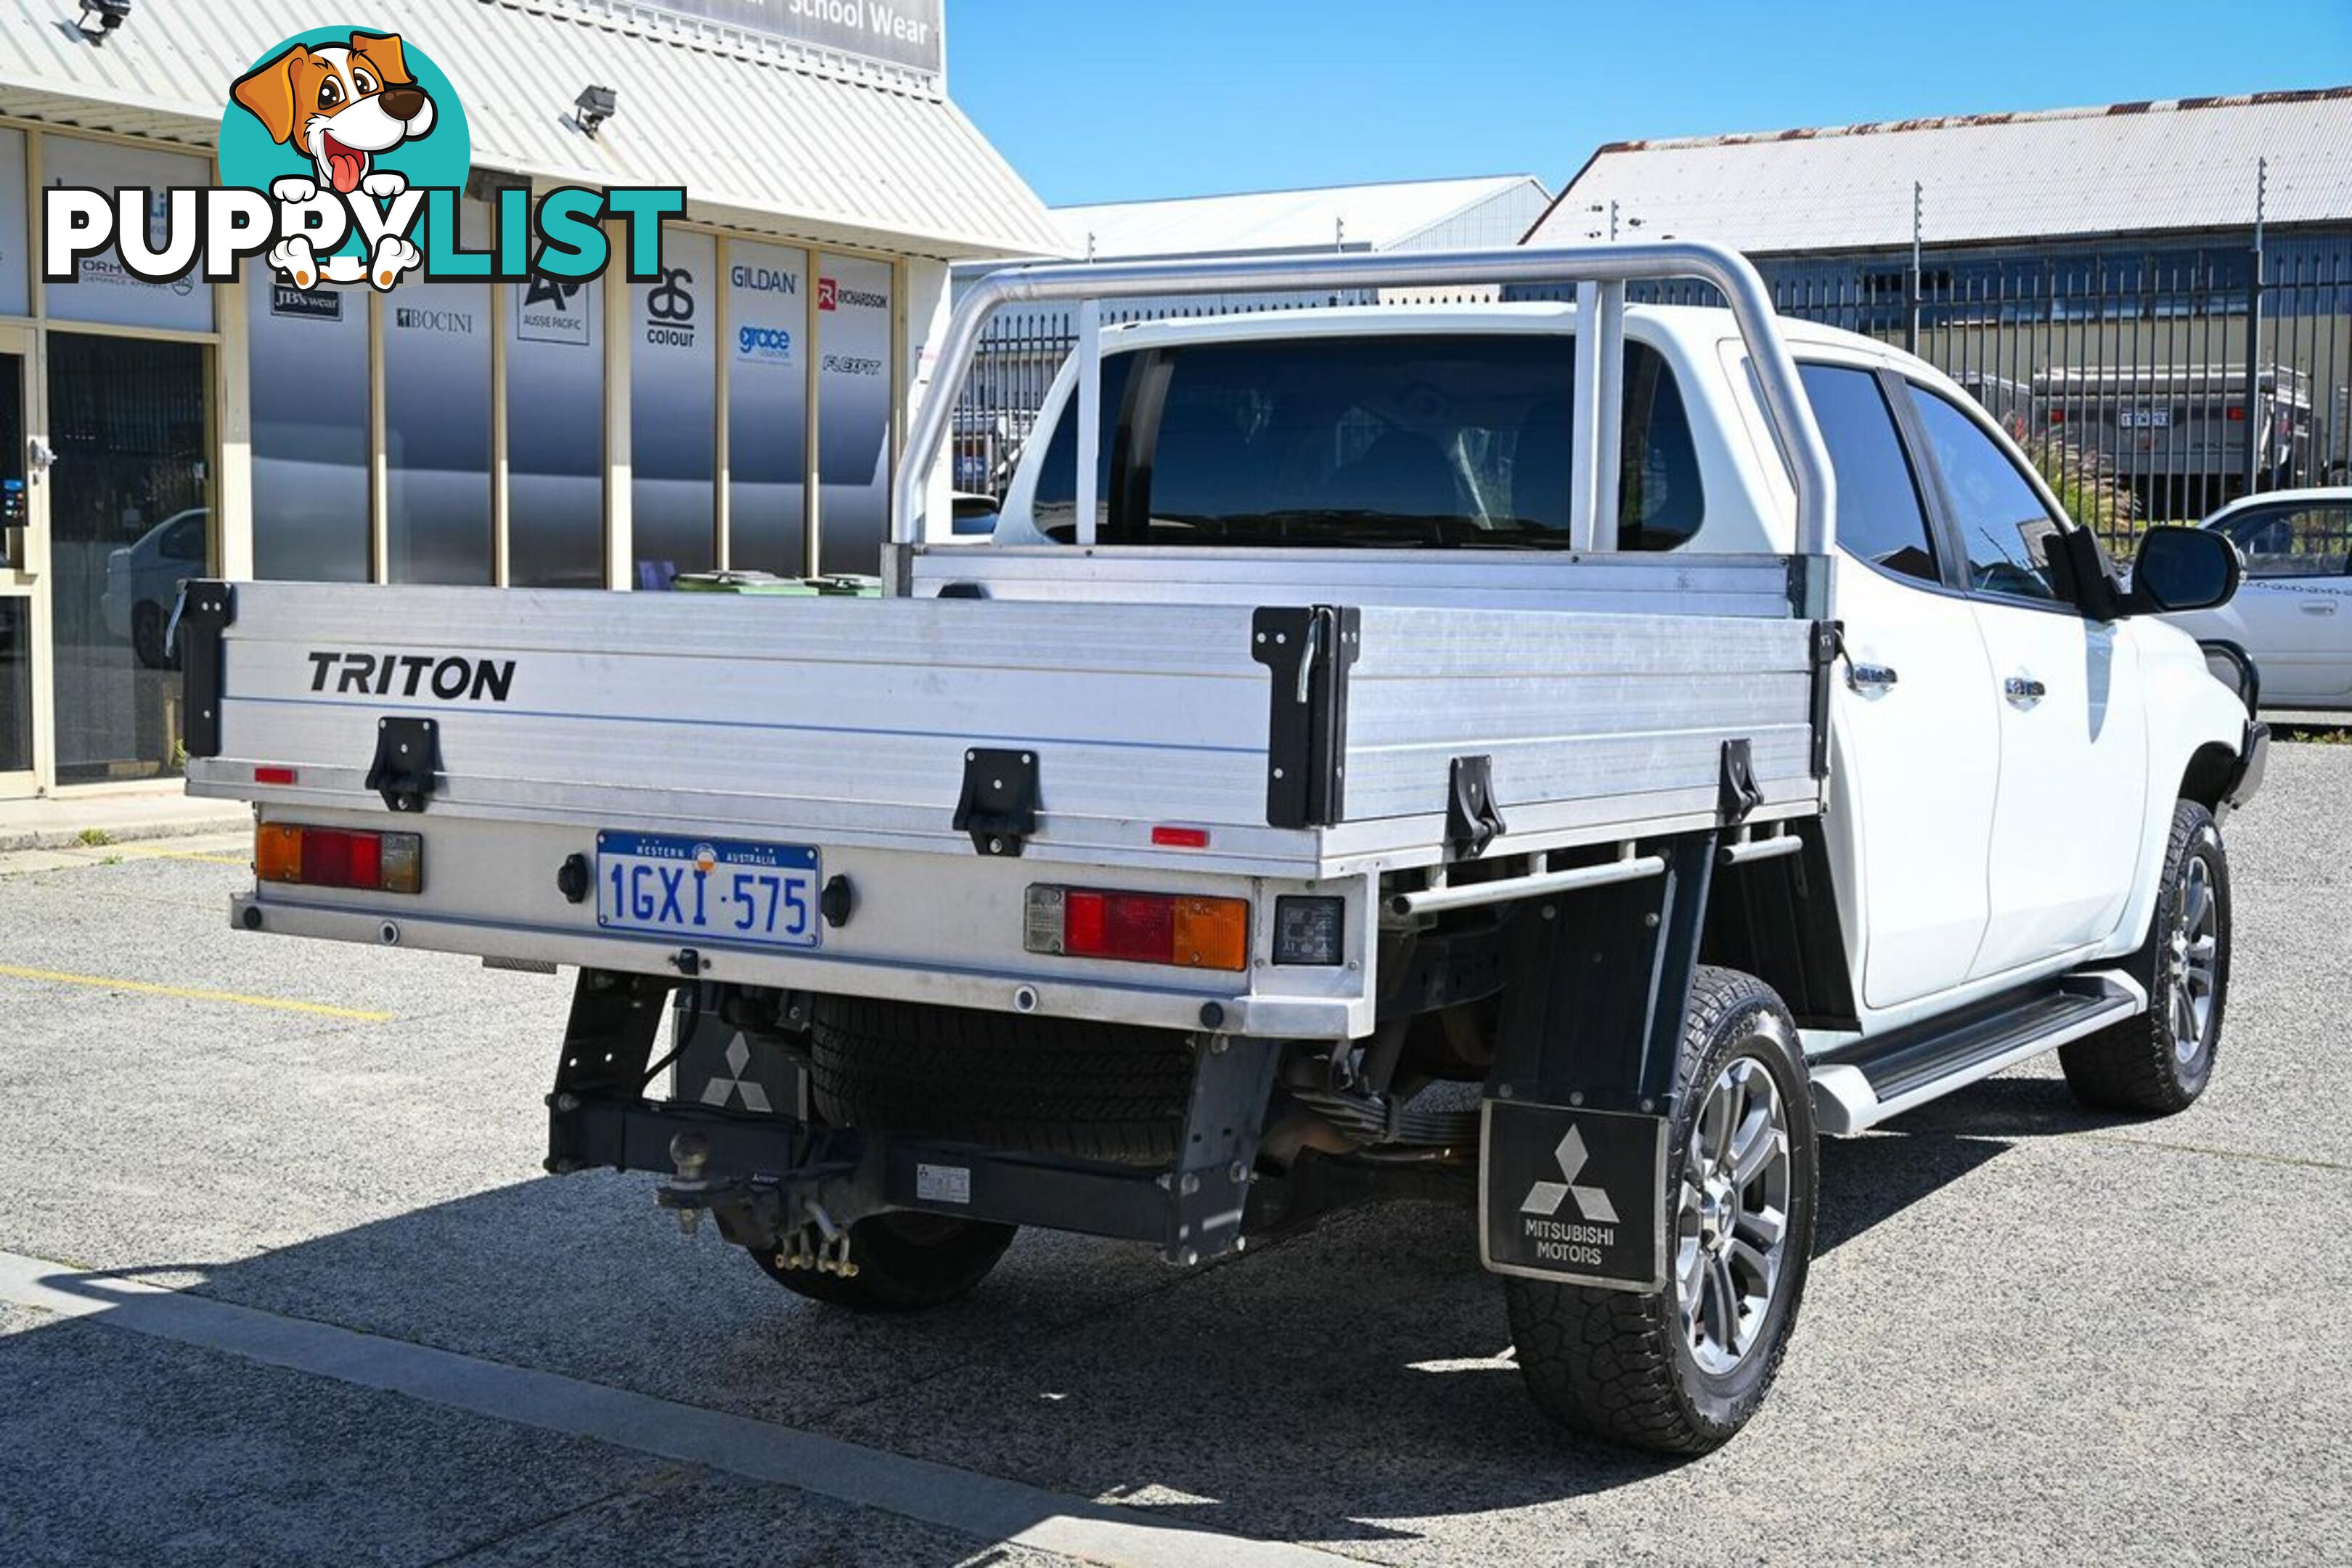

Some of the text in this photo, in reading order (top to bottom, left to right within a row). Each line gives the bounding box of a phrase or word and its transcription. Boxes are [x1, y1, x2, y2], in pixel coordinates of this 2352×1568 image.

[869, 2, 928, 44] Wear
[732, 266, 795, 293] GILDAN
[838, 290, 887, 309] RICHARDSON
[410, 309, 472, 333] BOCINI
[523, 314, 581, 330] AUSSIE PACIFIC
[648, 329, 694, 347] colour
[740, 327, 790, 354] grace
[308, 651, 516, 702] TRITON
[637, 846, 777, 865] WESTERN AUSTRALIA
[1526, 1219, 1614, 1246] MITSUBISHI
[1538, 1241, 1601, 1265] MOTORS
